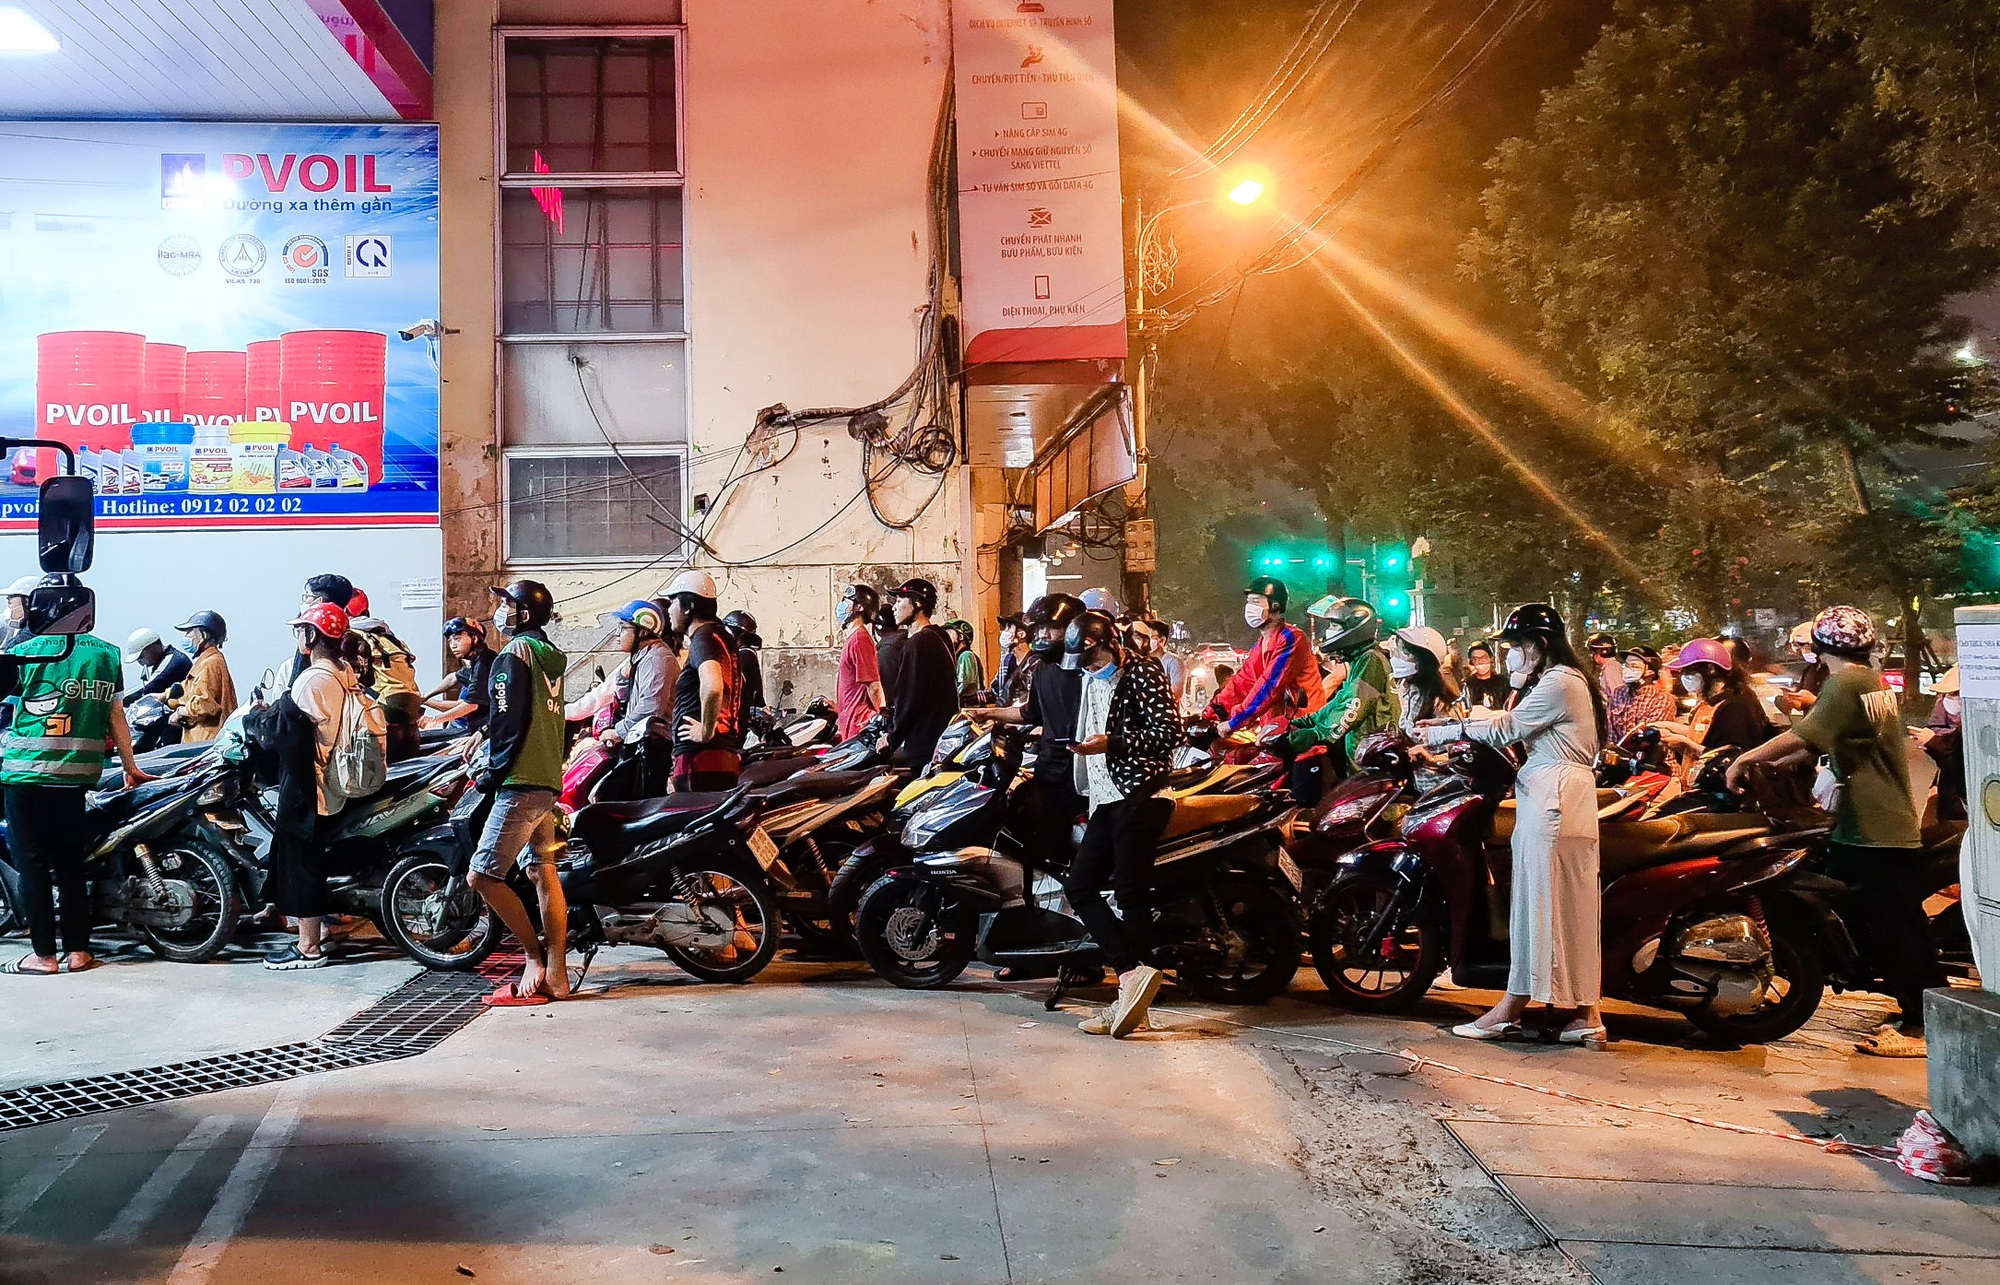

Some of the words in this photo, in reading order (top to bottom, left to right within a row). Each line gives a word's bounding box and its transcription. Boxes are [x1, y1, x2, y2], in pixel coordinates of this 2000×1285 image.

[1003, 127, 1024, 138] NÂNG
[1058, 128, 1068, 137] 4G
[223, 153, 392, 193] PVOIL
[1011, 161, 1031, 170] SANG
[1033, 160, 1061, 169] VIETTEL
[1010, 183, 1025, 192] SIM
[1063, 181, 1082, 190] DATA
[289, 201, 308, 211] xa
[313, 198, 355, 211] thêm
[361, 196, 392, 214] gần
[1032, 234, 1052, 244] PHÁT
[1054, 234, 1082, 244] NHANH
[311, 269, 329, 278] SGS
[46, 403, 137, 427] PVOIL
[290, 401, 378, 425] PVOIL
[102, 499, 175, 514] Hotline:
[181, 498, 223, 513] 0912
[228, 498, 249, 512] 02
[255, 498, 275, 512] 02
[281, 497, 302, 512] 02
[495, 682, 509, 713] gojek
